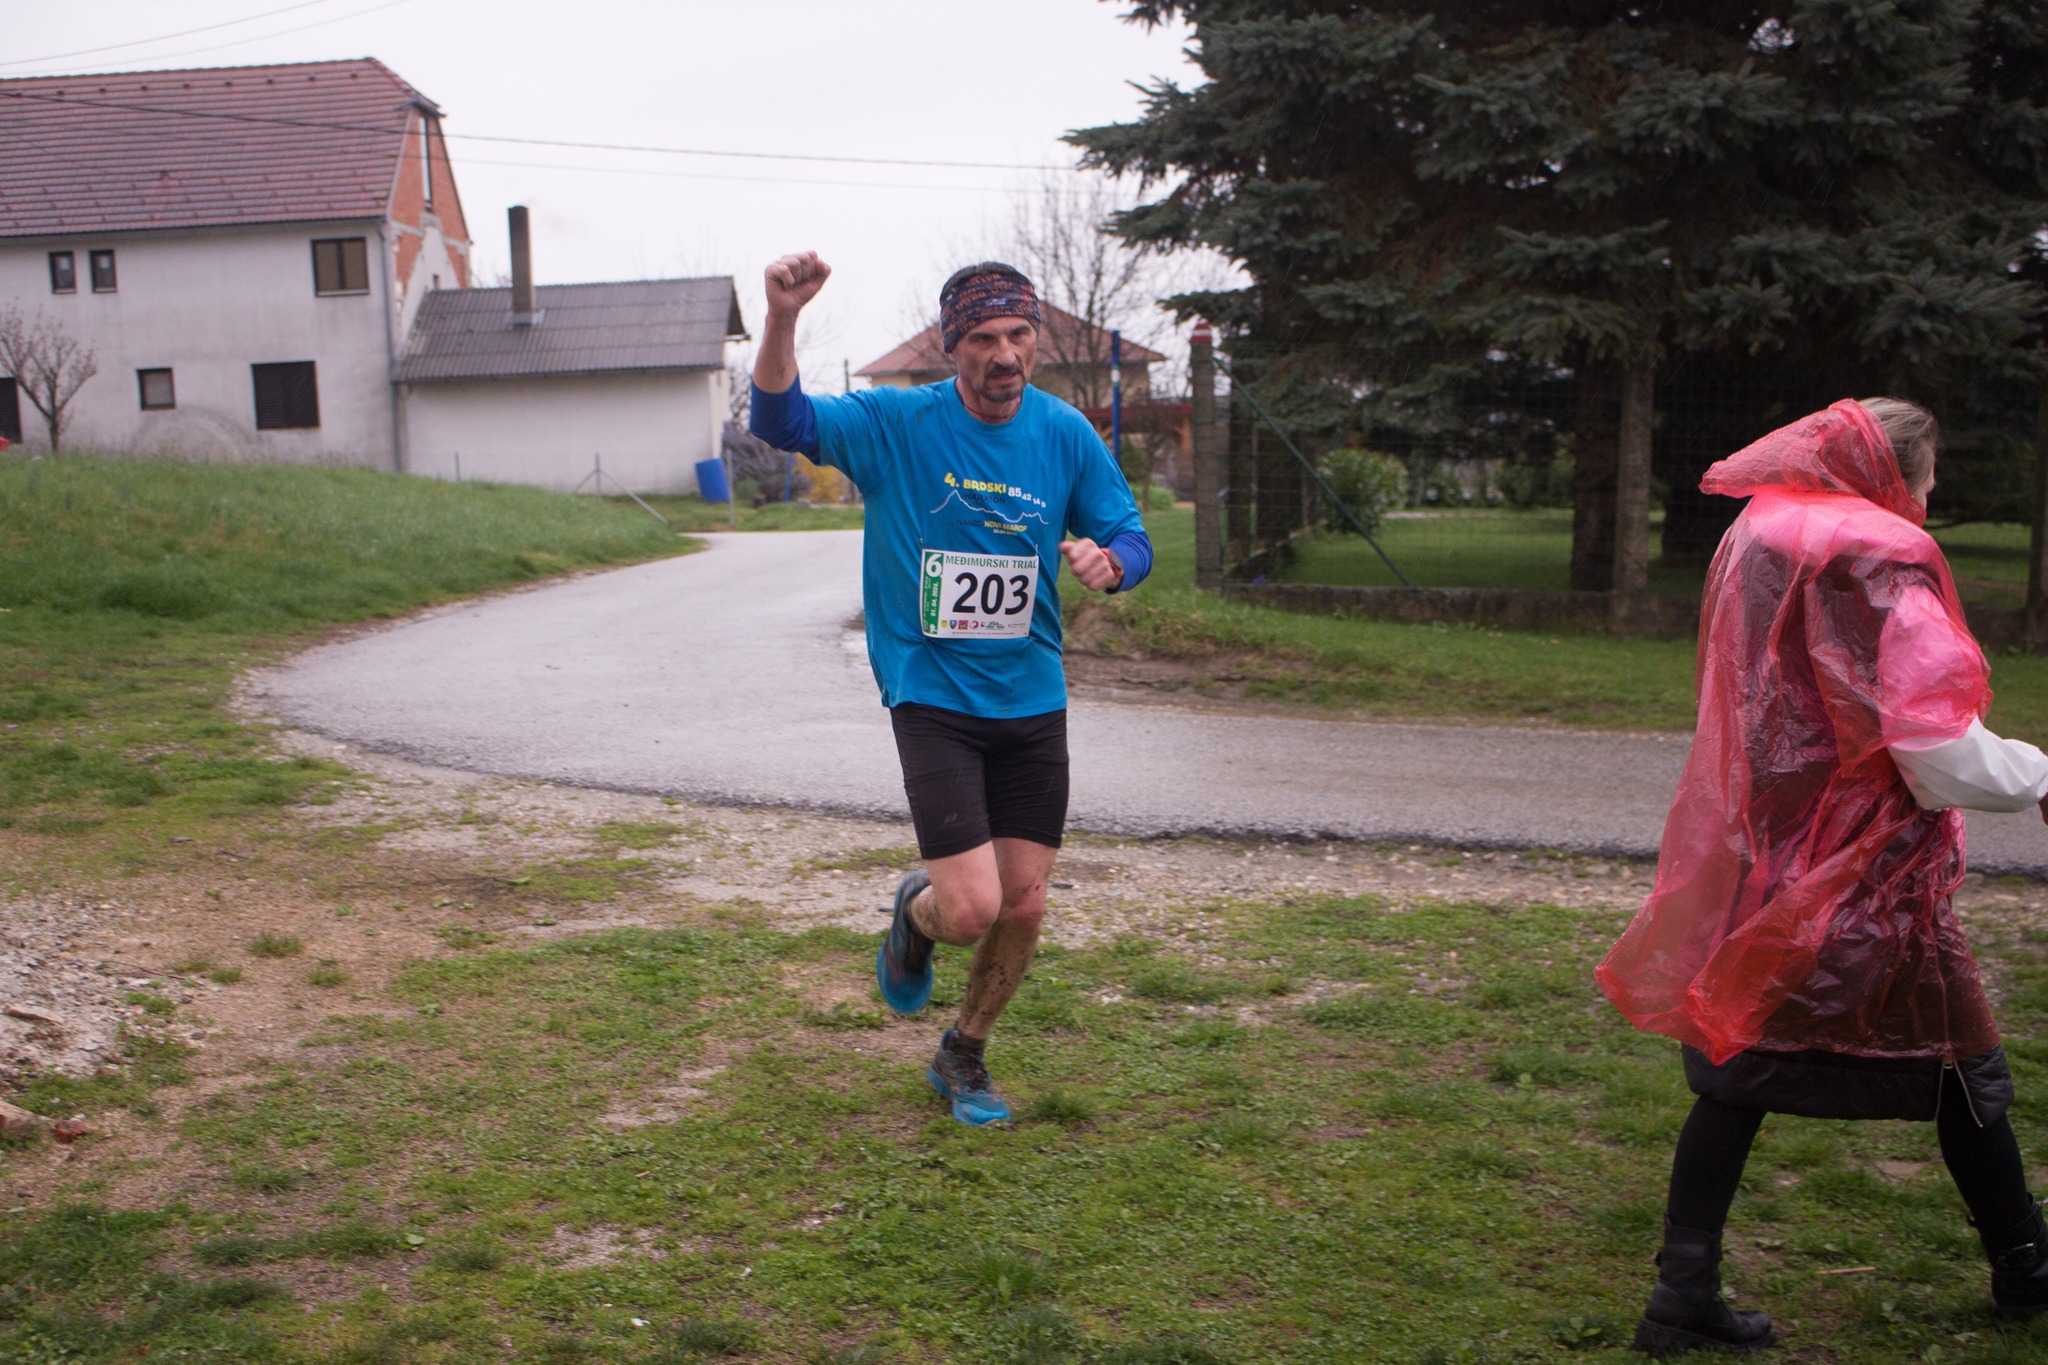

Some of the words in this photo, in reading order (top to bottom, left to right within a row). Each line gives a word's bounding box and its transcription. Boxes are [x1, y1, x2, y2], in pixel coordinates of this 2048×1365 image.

[944, 472, 960, 488] 4.
[963, 478, 1007, 494] BRDSKI
[1008, 486, 1021, 498] 85
[1012, 560, 1037, 569] TRIAL
[952, 572, 1029, 615] 203
